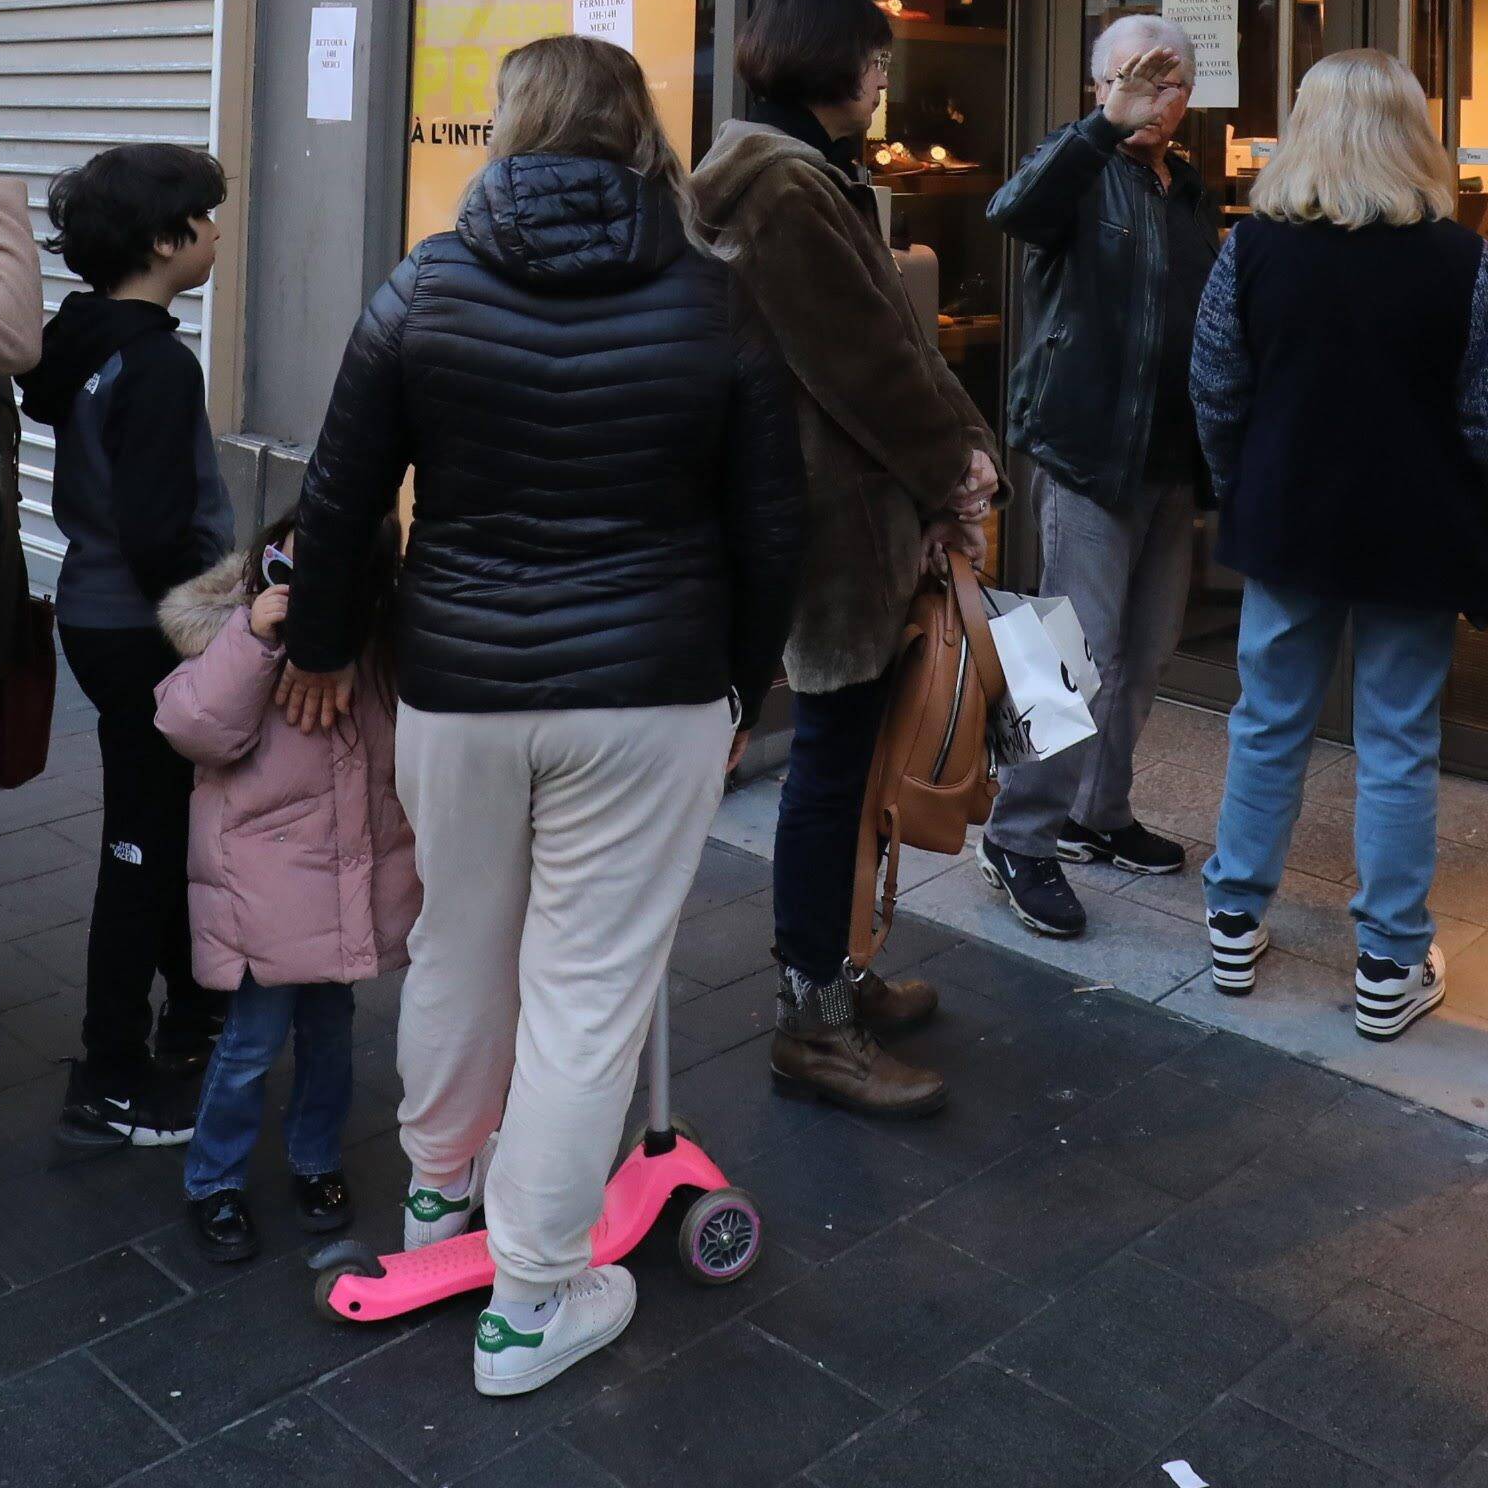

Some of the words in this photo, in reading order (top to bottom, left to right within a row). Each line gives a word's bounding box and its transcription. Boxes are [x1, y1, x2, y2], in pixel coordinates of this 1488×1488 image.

[588, 10, 617, 21] 13H-14H
[590, 22, 616, 33] MERCI
[411, 117, 425, 144] À
